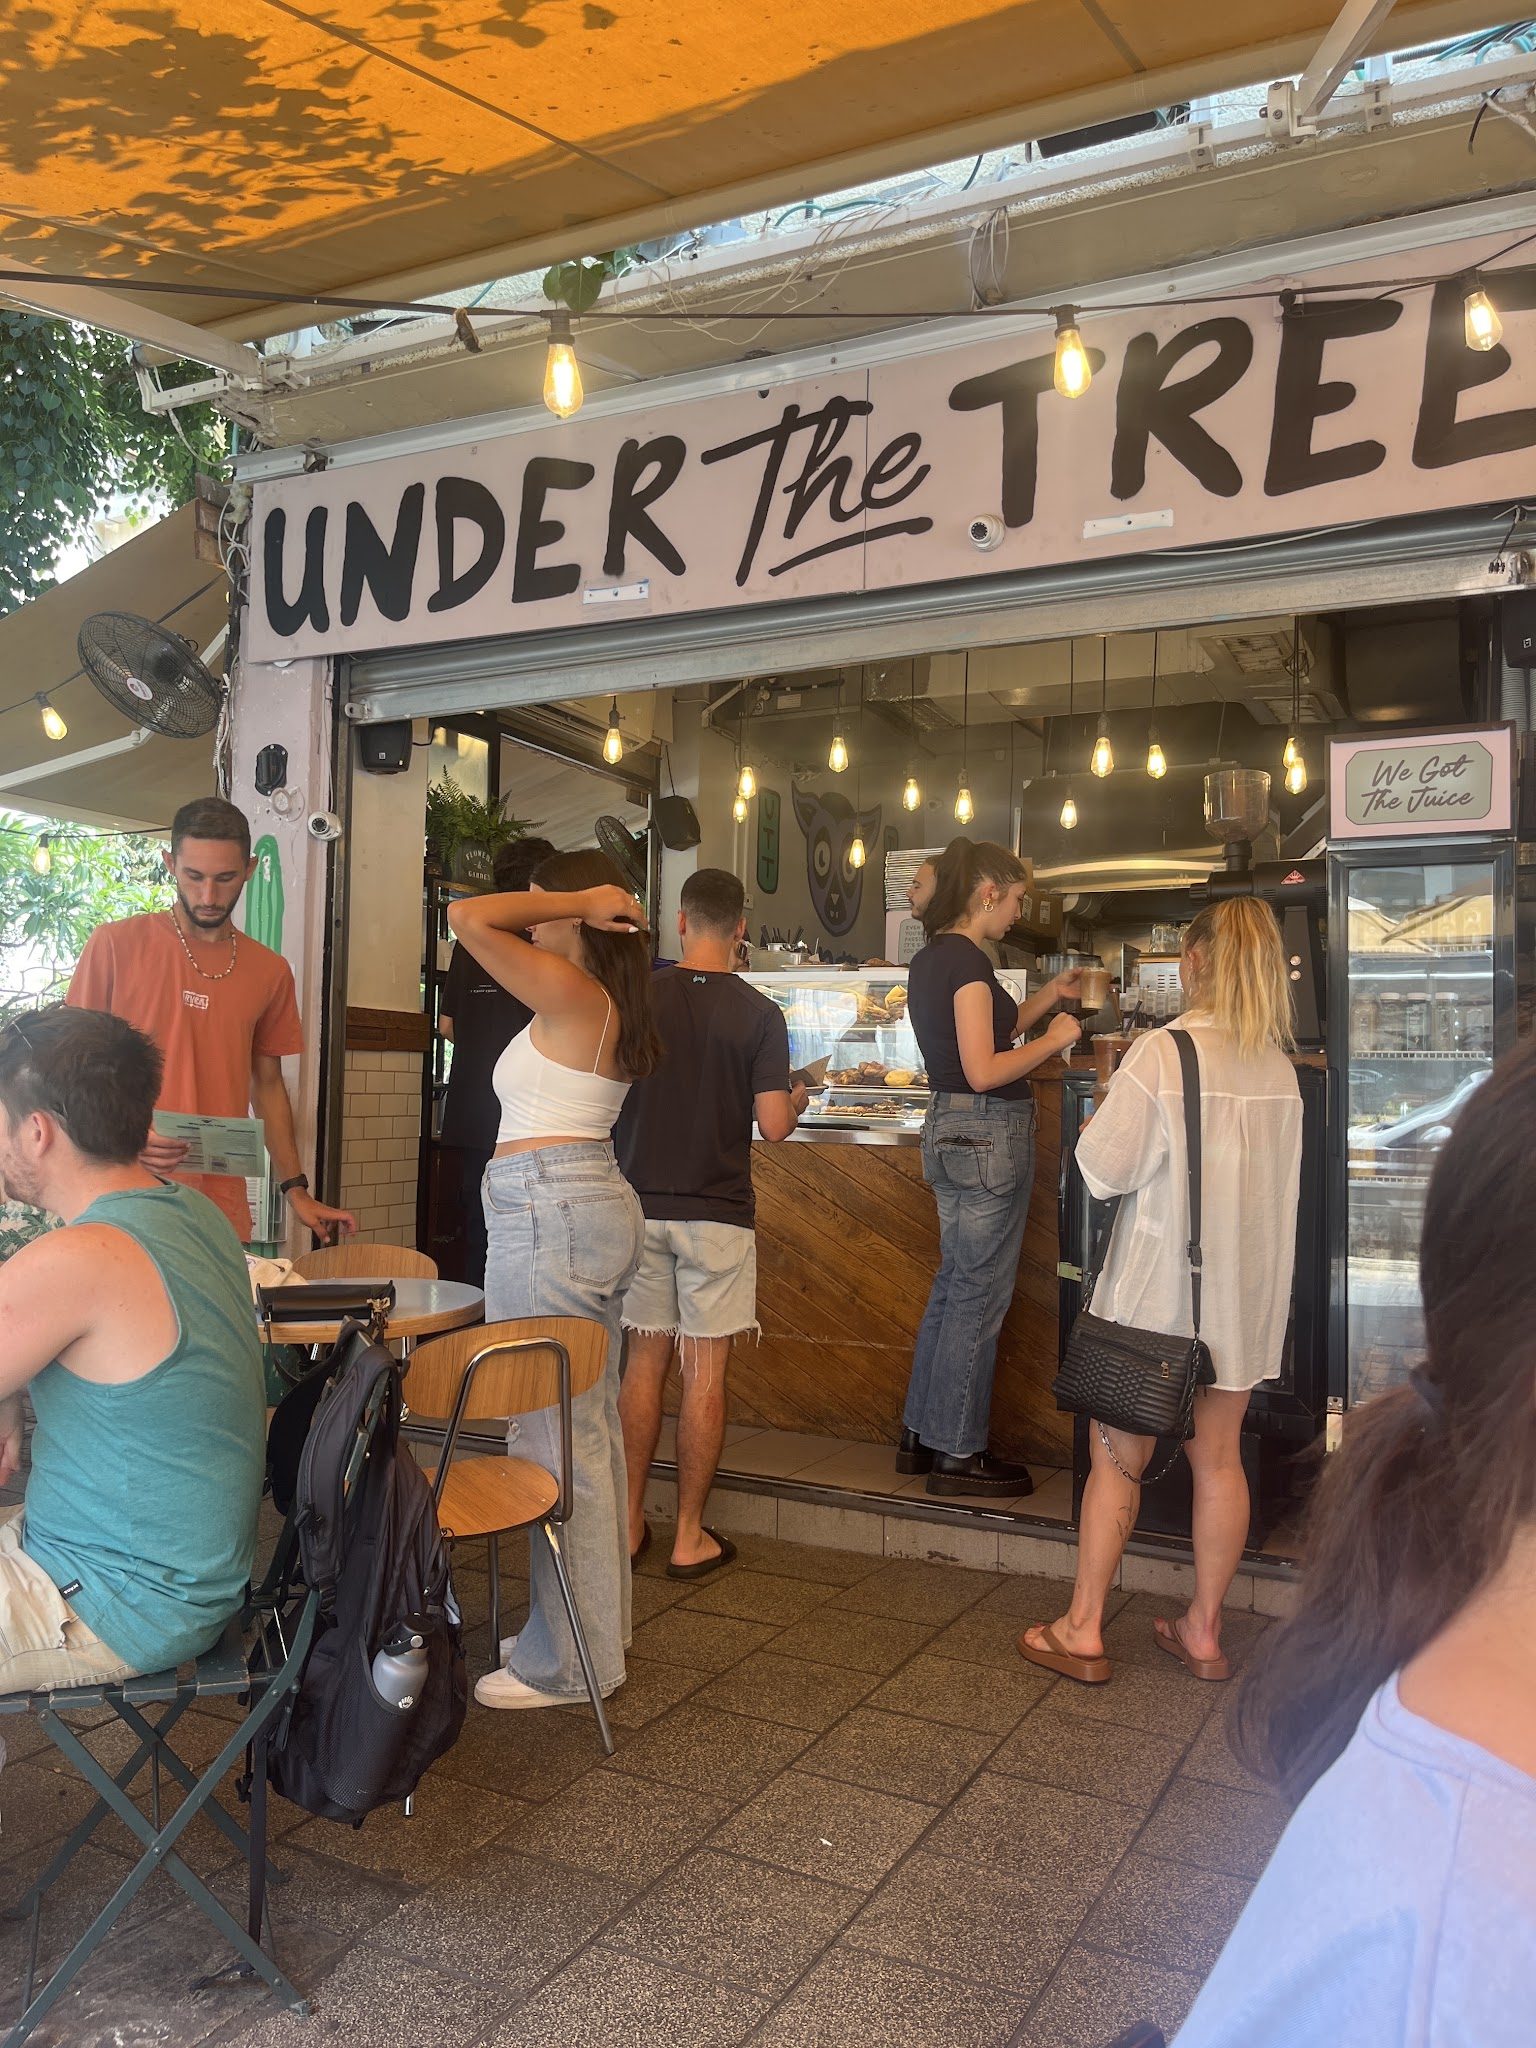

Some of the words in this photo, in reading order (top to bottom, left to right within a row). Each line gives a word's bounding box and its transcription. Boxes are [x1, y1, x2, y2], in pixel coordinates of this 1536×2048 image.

[264, 435, 687, 637] UNDER
[701, 396, 932, 587] The
[949, 264, 1536, 528] TREE
[1371, 760, 1413, 787] We
[1419, 754, 1475, 784] Got
[1361, 788, 1402, 817] The
[1407, 786, 1475, 814] Juice
